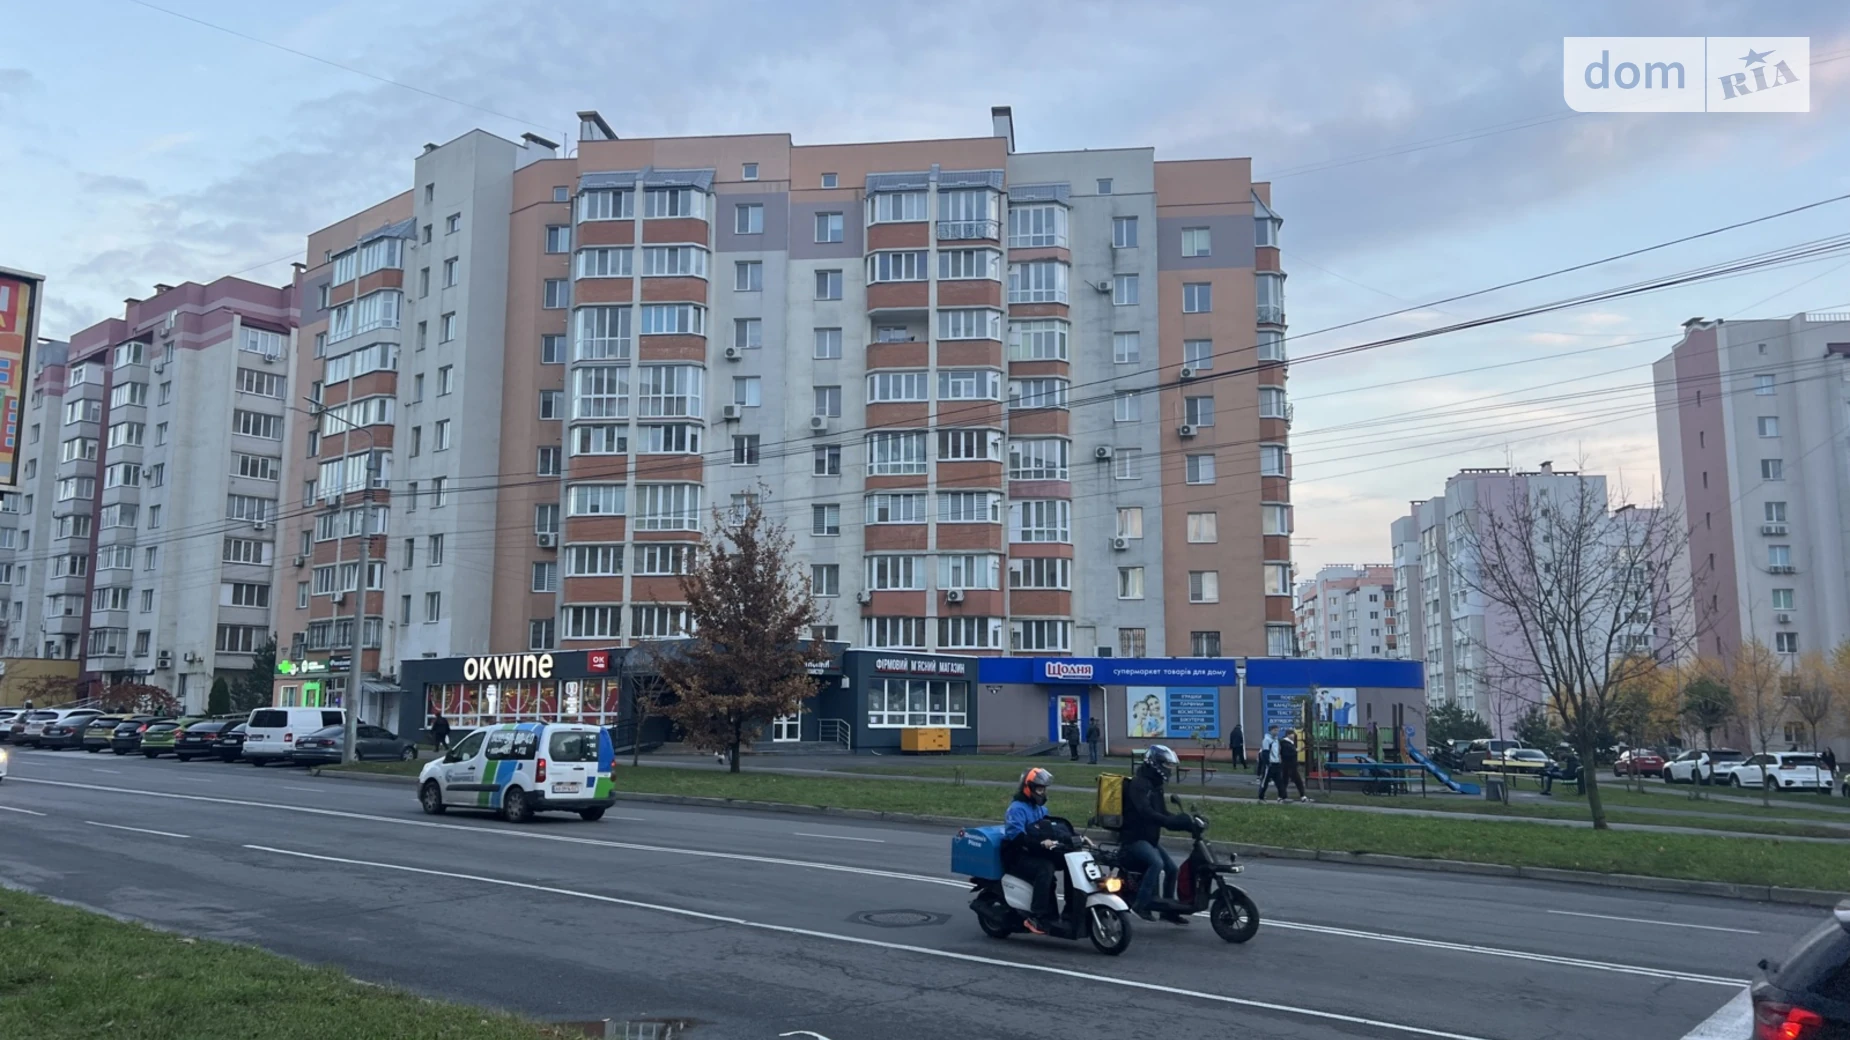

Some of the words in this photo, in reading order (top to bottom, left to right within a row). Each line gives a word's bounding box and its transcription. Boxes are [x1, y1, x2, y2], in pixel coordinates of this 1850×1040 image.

[592, 656, 605, 664] OK
[876, 658, 908, 670] ФІРМОВИЙ
[939, 661, 965, 674] МАГАЗИН
[1112, 667, 1162, 677] супермаркет
[1163, 667, 1192, 677] товарів
[1192, 669, 1206, 677] для
[1207, 669, 1227, 678] дому
